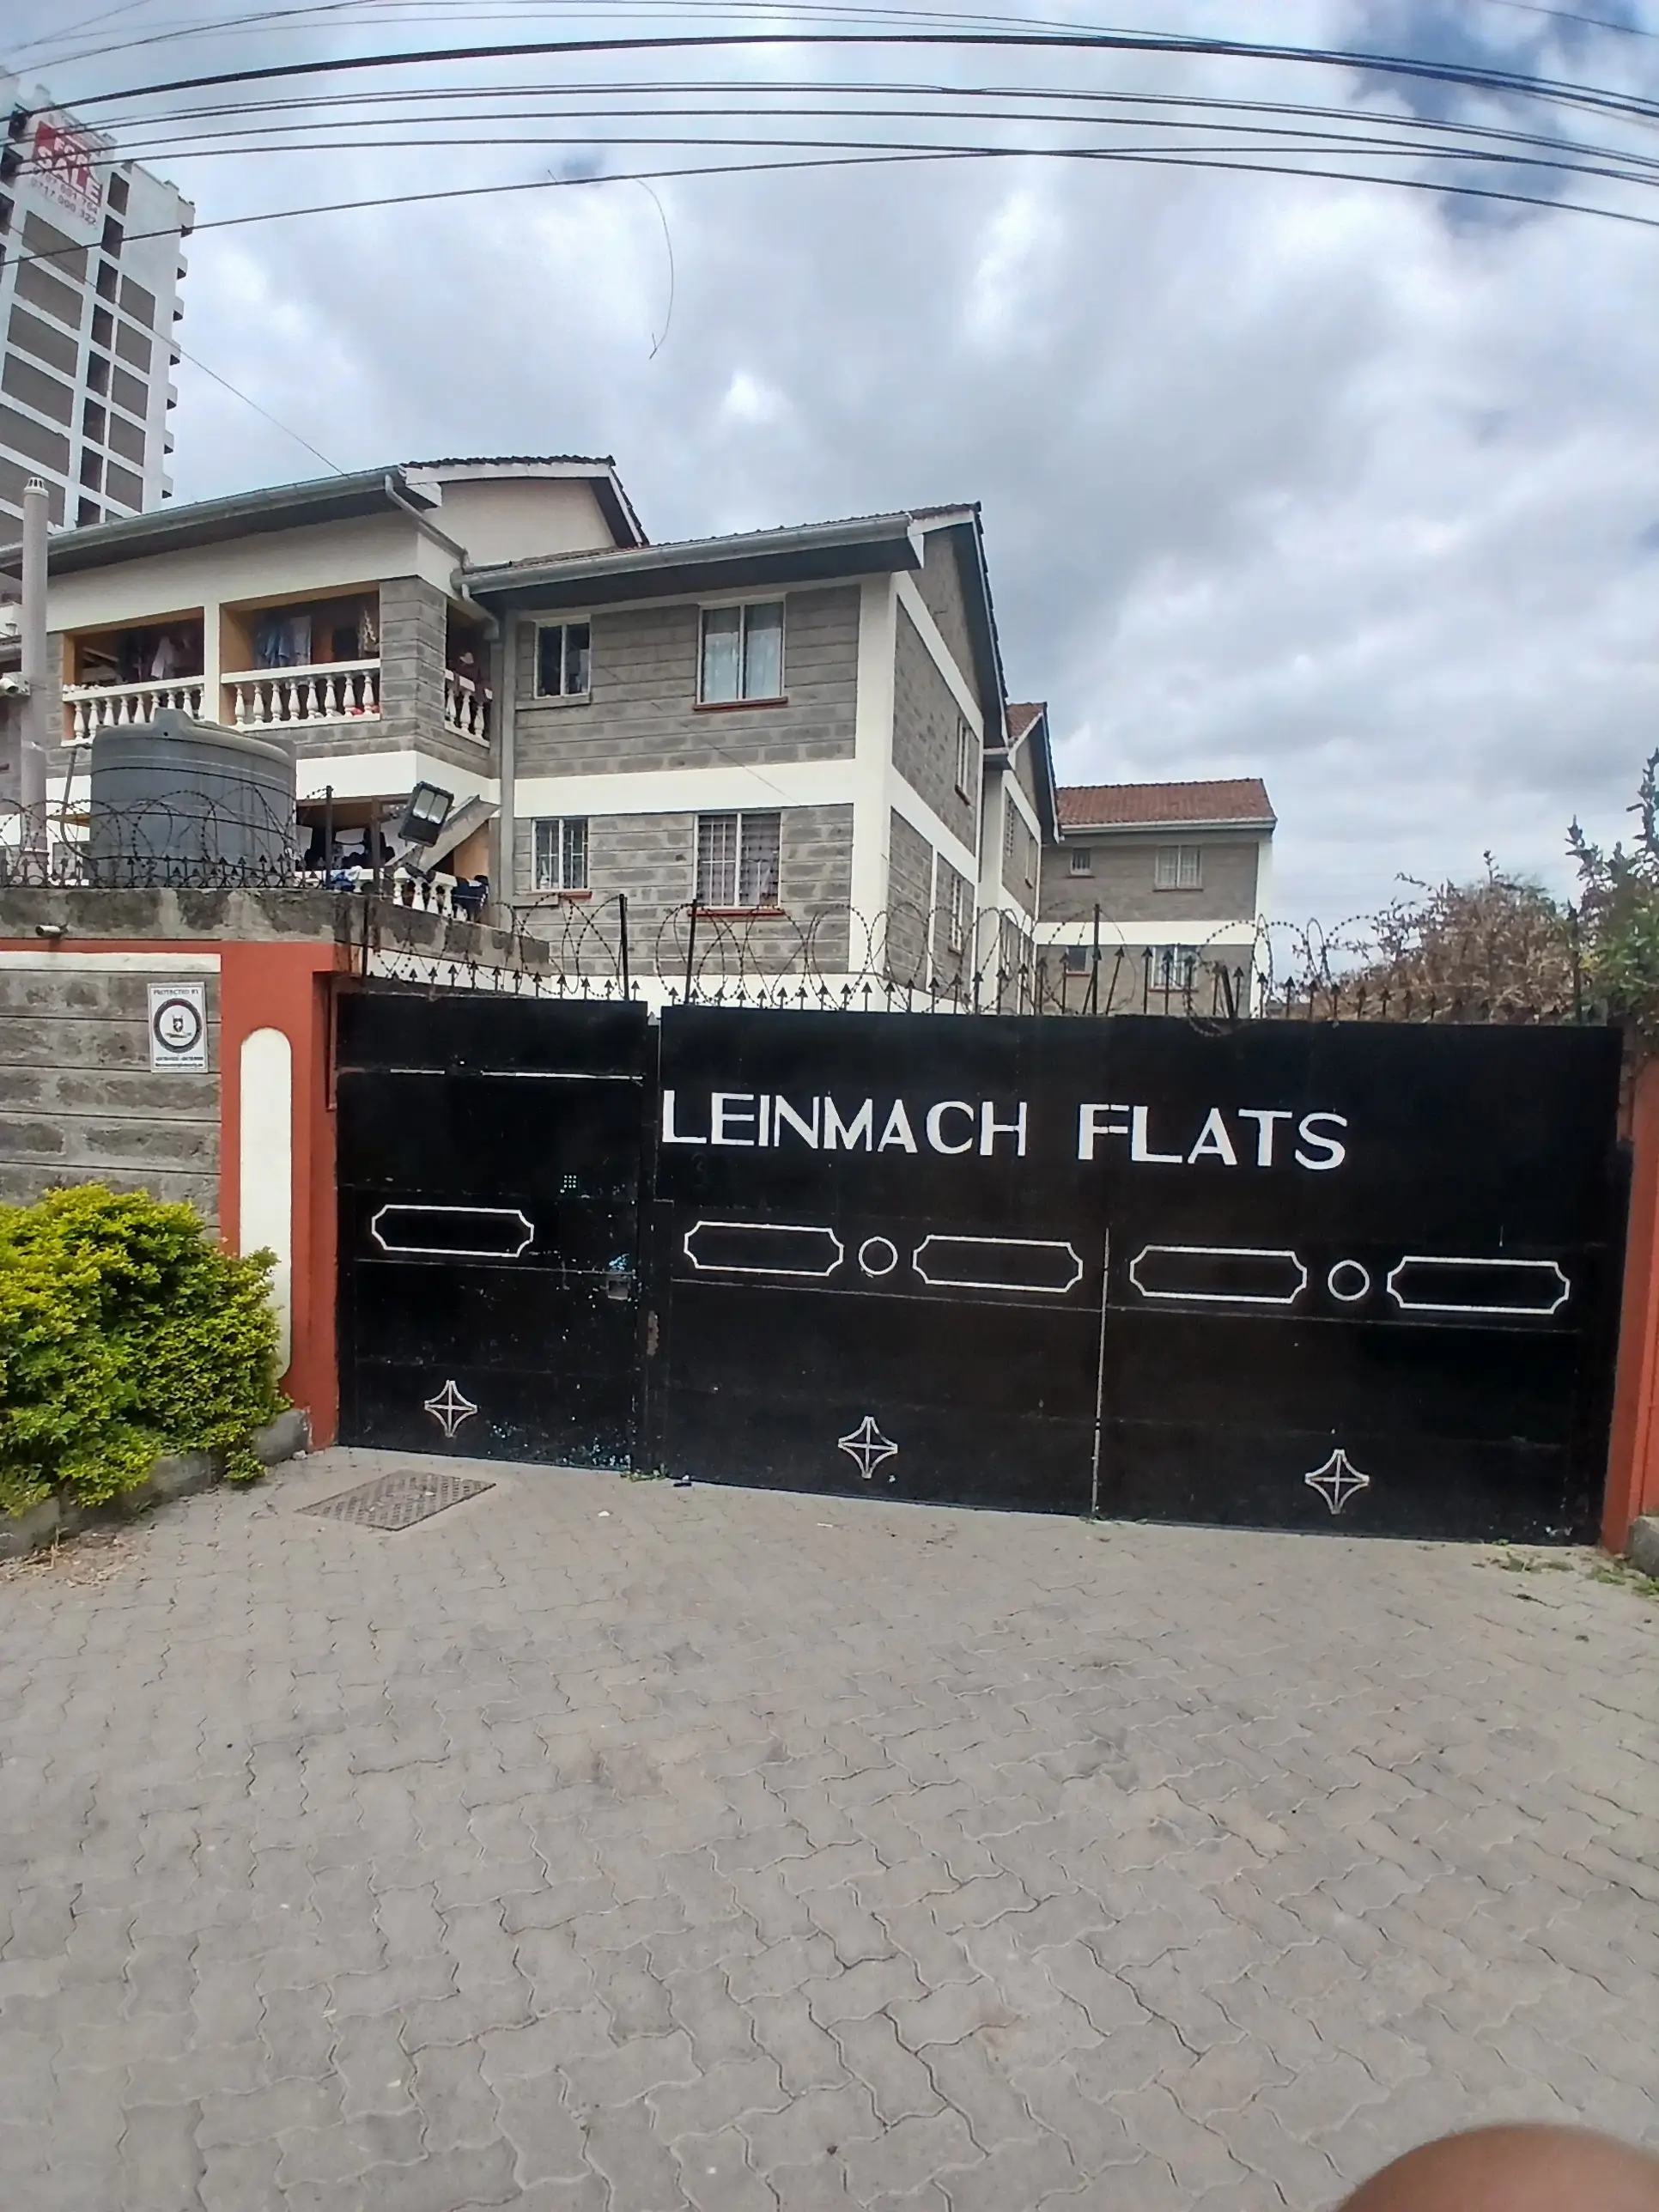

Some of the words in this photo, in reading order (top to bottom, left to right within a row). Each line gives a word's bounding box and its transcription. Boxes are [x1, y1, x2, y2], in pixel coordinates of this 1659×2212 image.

[38, 147, 100, 205] SALE
[54, 137, 88, 172] FOR
[661, 1090, 1028, 1157] LEINMACH
[1078, 1103, 1348, 1170] FLATS
